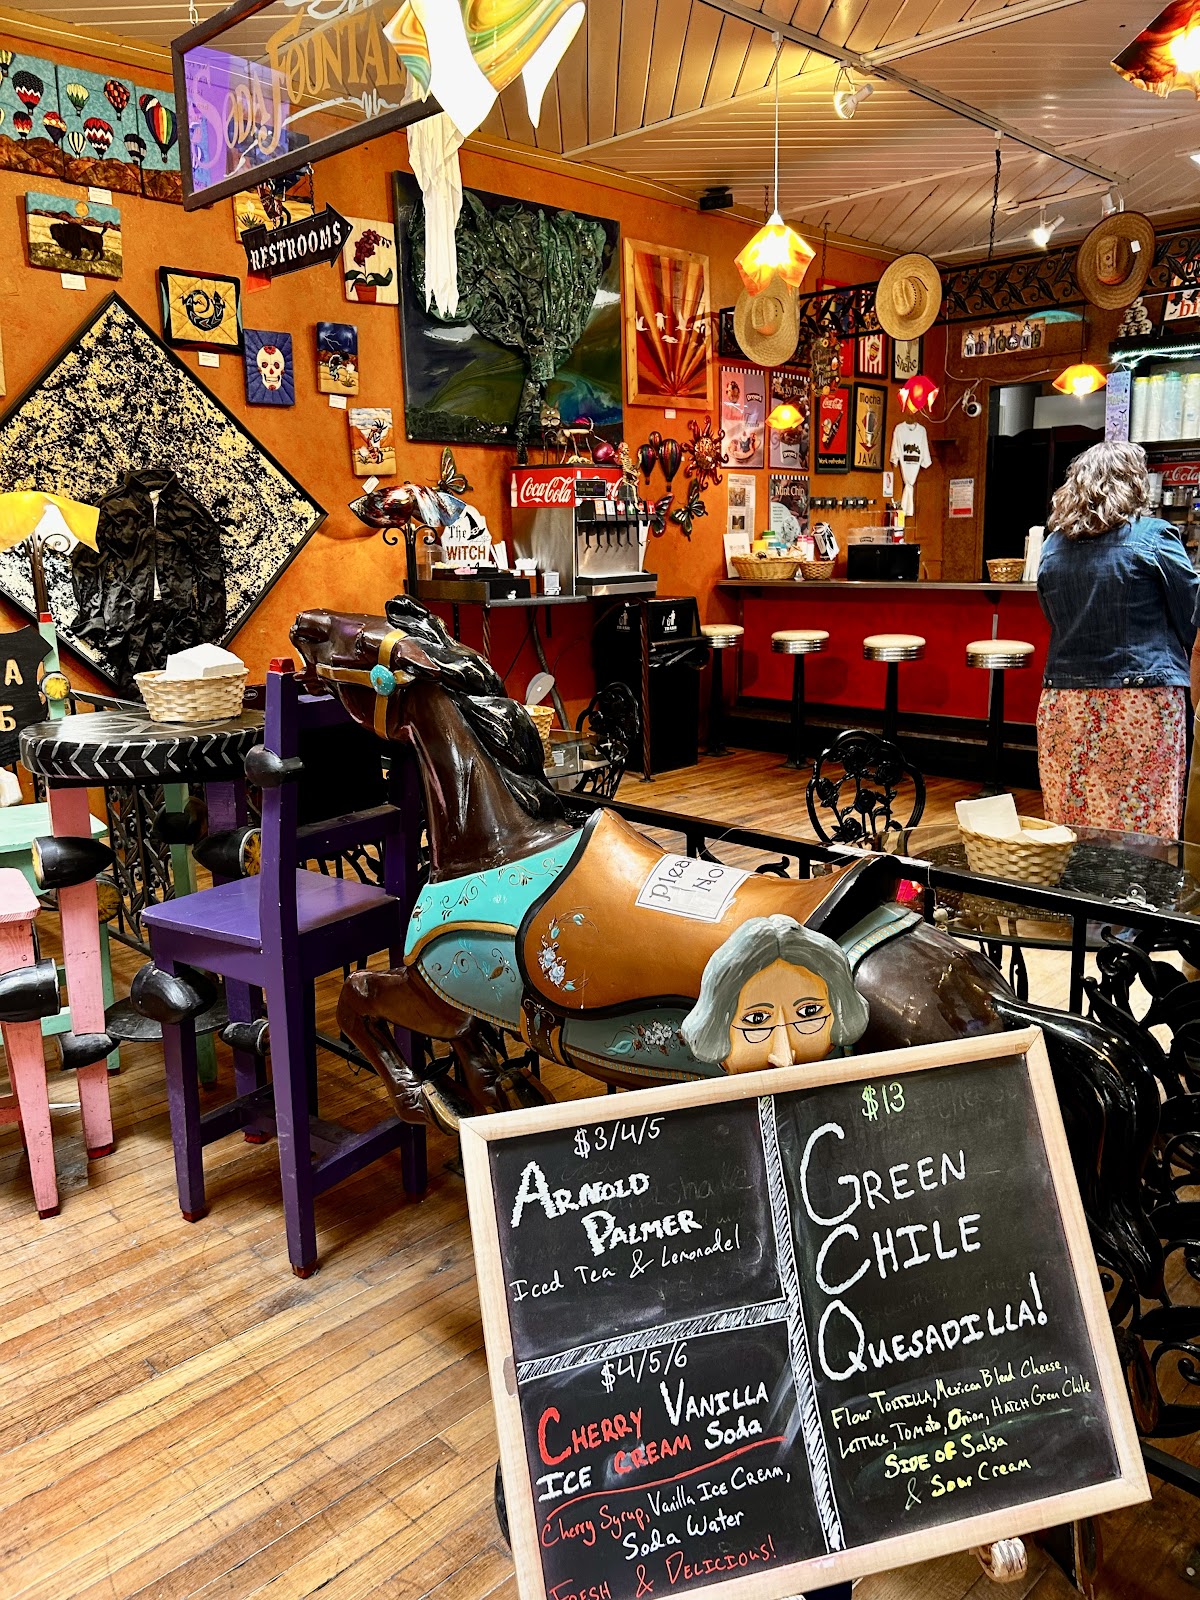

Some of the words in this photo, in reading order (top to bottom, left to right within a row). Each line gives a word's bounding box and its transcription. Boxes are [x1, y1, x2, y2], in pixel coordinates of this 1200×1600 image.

[250, 221, 342, 270] RESTROOMS
[859, 392, 881, 406] Mocha
[857, 452, 878, 466] JAVA
[520, 476, 575, 503] Coca-Cola
[775, 485, 790, 497] Mint
[790, 486, 805, 498] Chip
[448, 525, 466, 540] The
[446, 545, 486, 561] WITCH
[862, 1081, 906, 1122] $13
[574, 1116, 665, 1159] $3/4/5
[800, 1122, 967, 1226] GREEN
[511, 1160, 650, 1229] ARNOLD
[581, 1208, 703, 1257] PALMER
[574, 1265, 616, 1286] Tea
[629, 1248, 655, 1279] &
[816, 1213, 982, 1295] CHILE
[601, 1341, 688, 1393] $4/5/6
[538, 1407, 643, 1466] CHERRY
[660, 1378, 770, 1427] VANILLA
[535, 1465, 592, 1502] ICE
[613, 1434, 691, 1475] CREAM
[704, 1417, 763, 1451] Soda
[884, 1453, 931, 1480] SIDE
[904, 1476, 923, 1512] &
[930, 1473, 973, 1499] Sour
[541, 1518, 596, 1548] Cherry
[622, 1531, 681, 1561] Soda
[687, 1507, 745, 1537] Water
[635, 1564, 655, 1599] &
